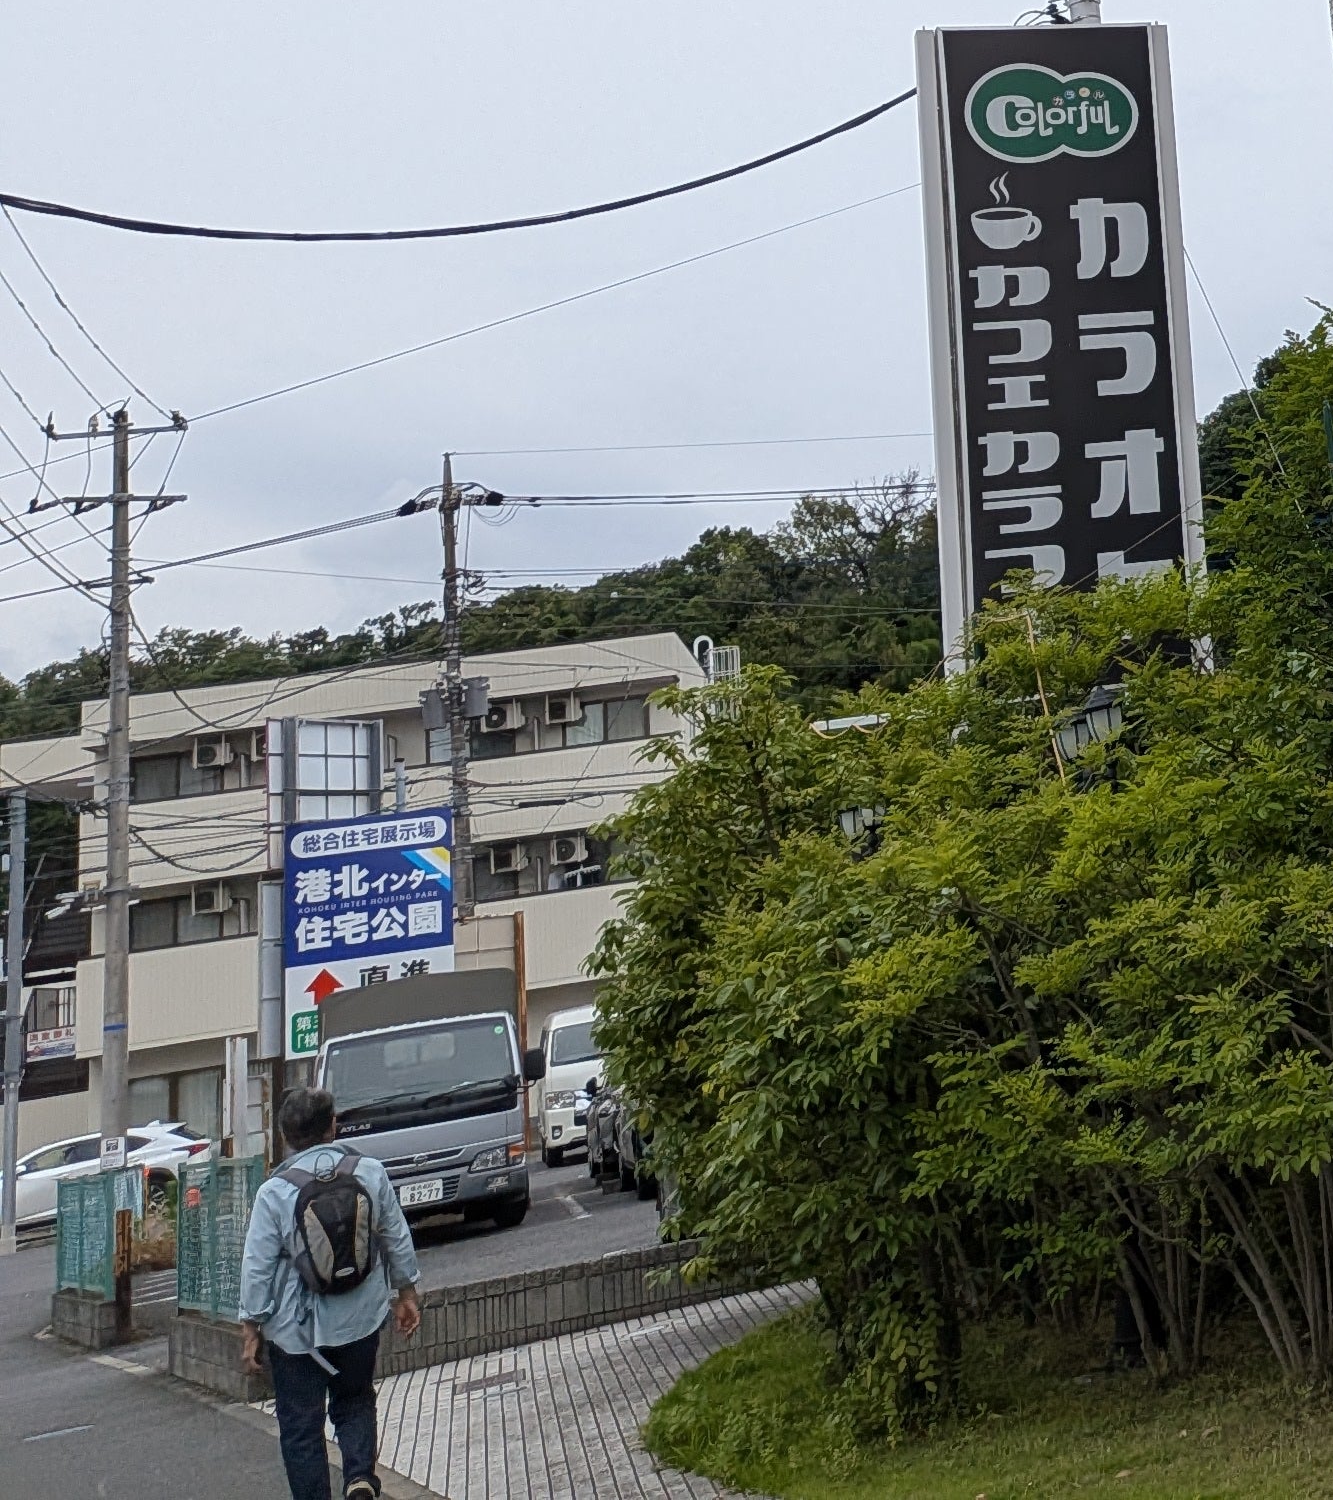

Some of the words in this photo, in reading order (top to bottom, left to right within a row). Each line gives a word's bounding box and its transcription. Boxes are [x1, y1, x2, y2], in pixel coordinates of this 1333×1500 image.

[986, 95, 1120, 137] Colorful
[969, 265, 1065, 594] カフェカラフ
[302, 821, 436, 853] 総合住宅展示場
[295, 864, 442, 904] 港北インター
[370, 894, 412, 905] HOUSING
[294, 900, 443, 953] 住宅公園
[340, 1123, 372, 1134] ATLAS
[409, 1187, 441, 1203] 82-77
